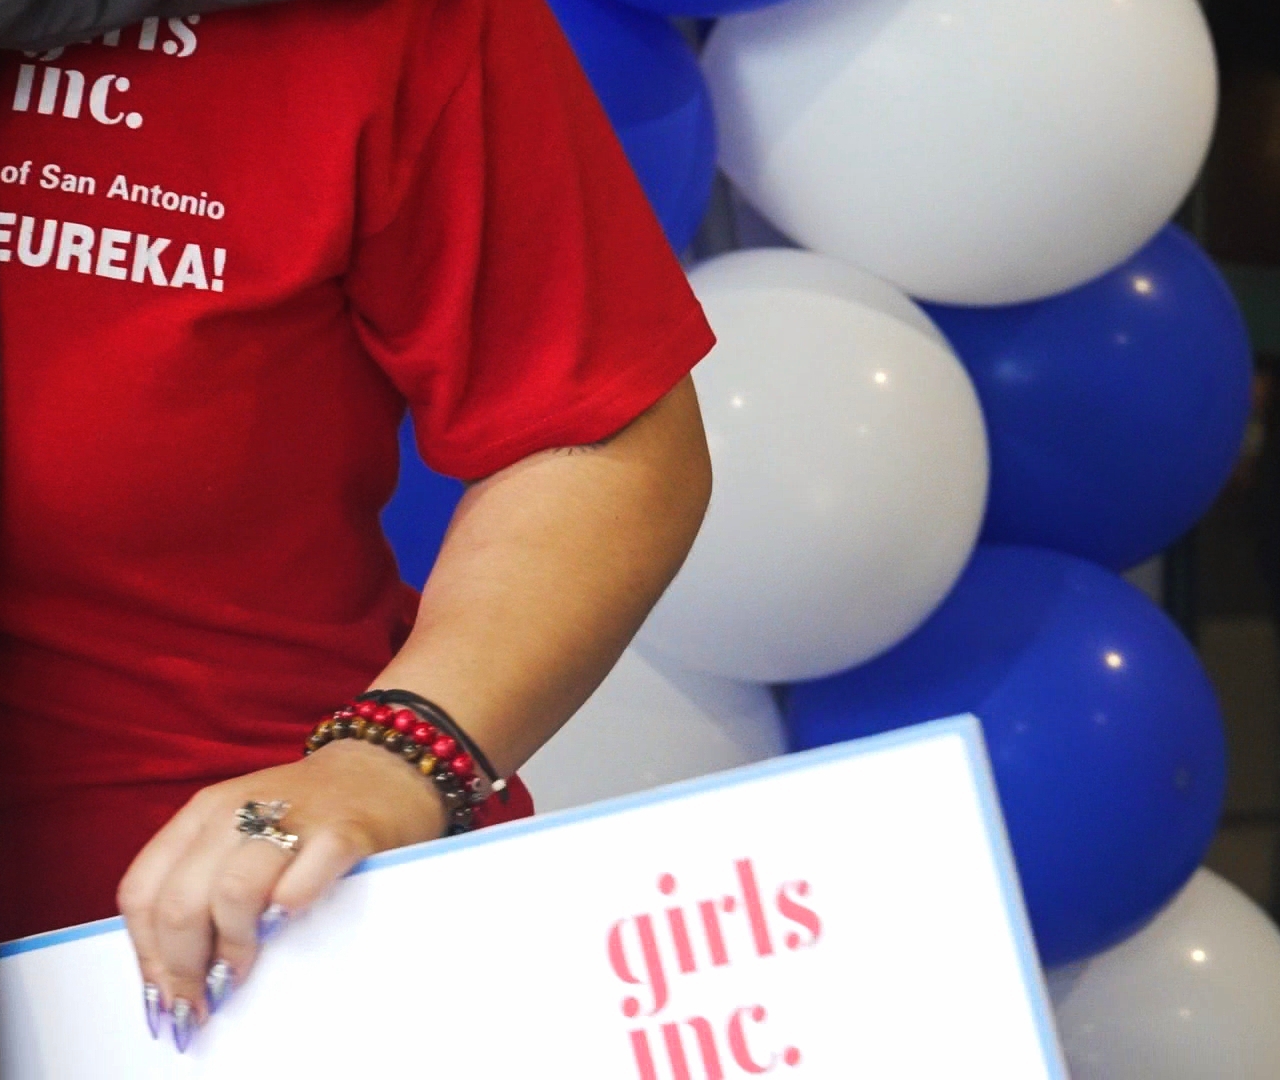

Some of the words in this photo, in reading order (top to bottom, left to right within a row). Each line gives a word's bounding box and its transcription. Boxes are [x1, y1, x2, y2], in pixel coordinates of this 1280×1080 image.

[11, 63, 143, 129] inc.
[0, 161, 32, 185] of
[39, 164, 96, 195] San
[106, 175, 225, 220] Antonio
[607, 856, 823, 1018] girls
[628, 1003, 802, 1080] inc.
